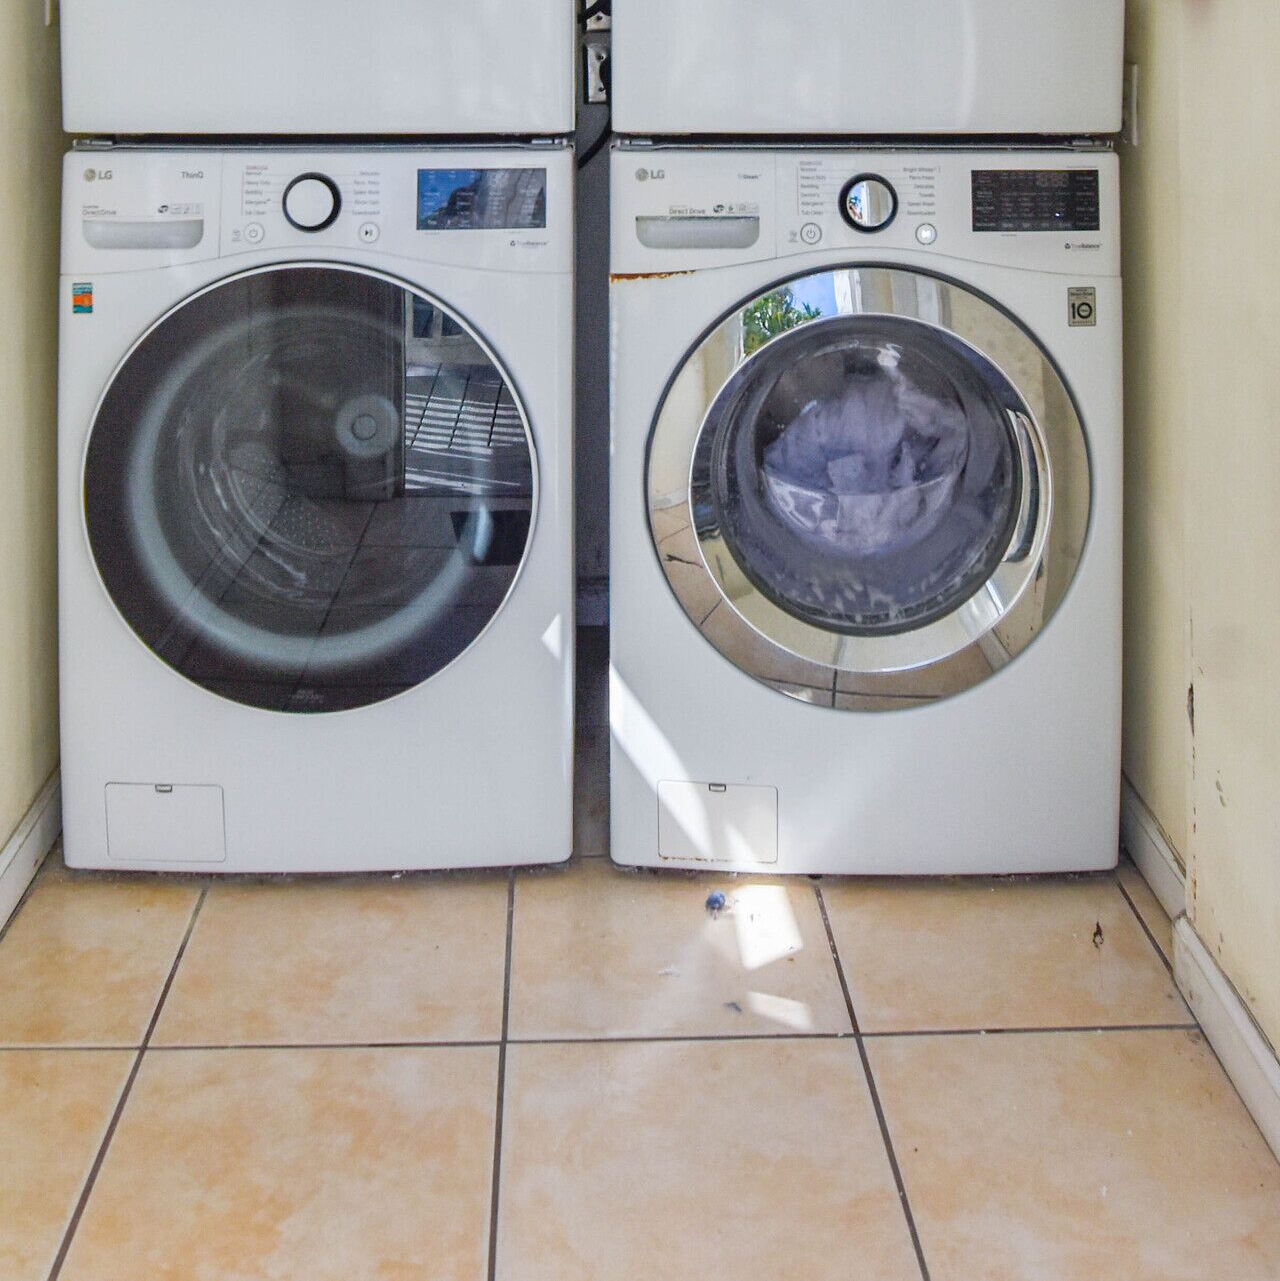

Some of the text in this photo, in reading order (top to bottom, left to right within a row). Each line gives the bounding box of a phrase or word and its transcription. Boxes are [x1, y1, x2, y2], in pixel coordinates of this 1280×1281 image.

[98, 170, 113, 180] LG
[181, 171, 204, 179] ThinQ
[650, 169, 665, 179] LG
[1071, 302, 1093, 319] 10
